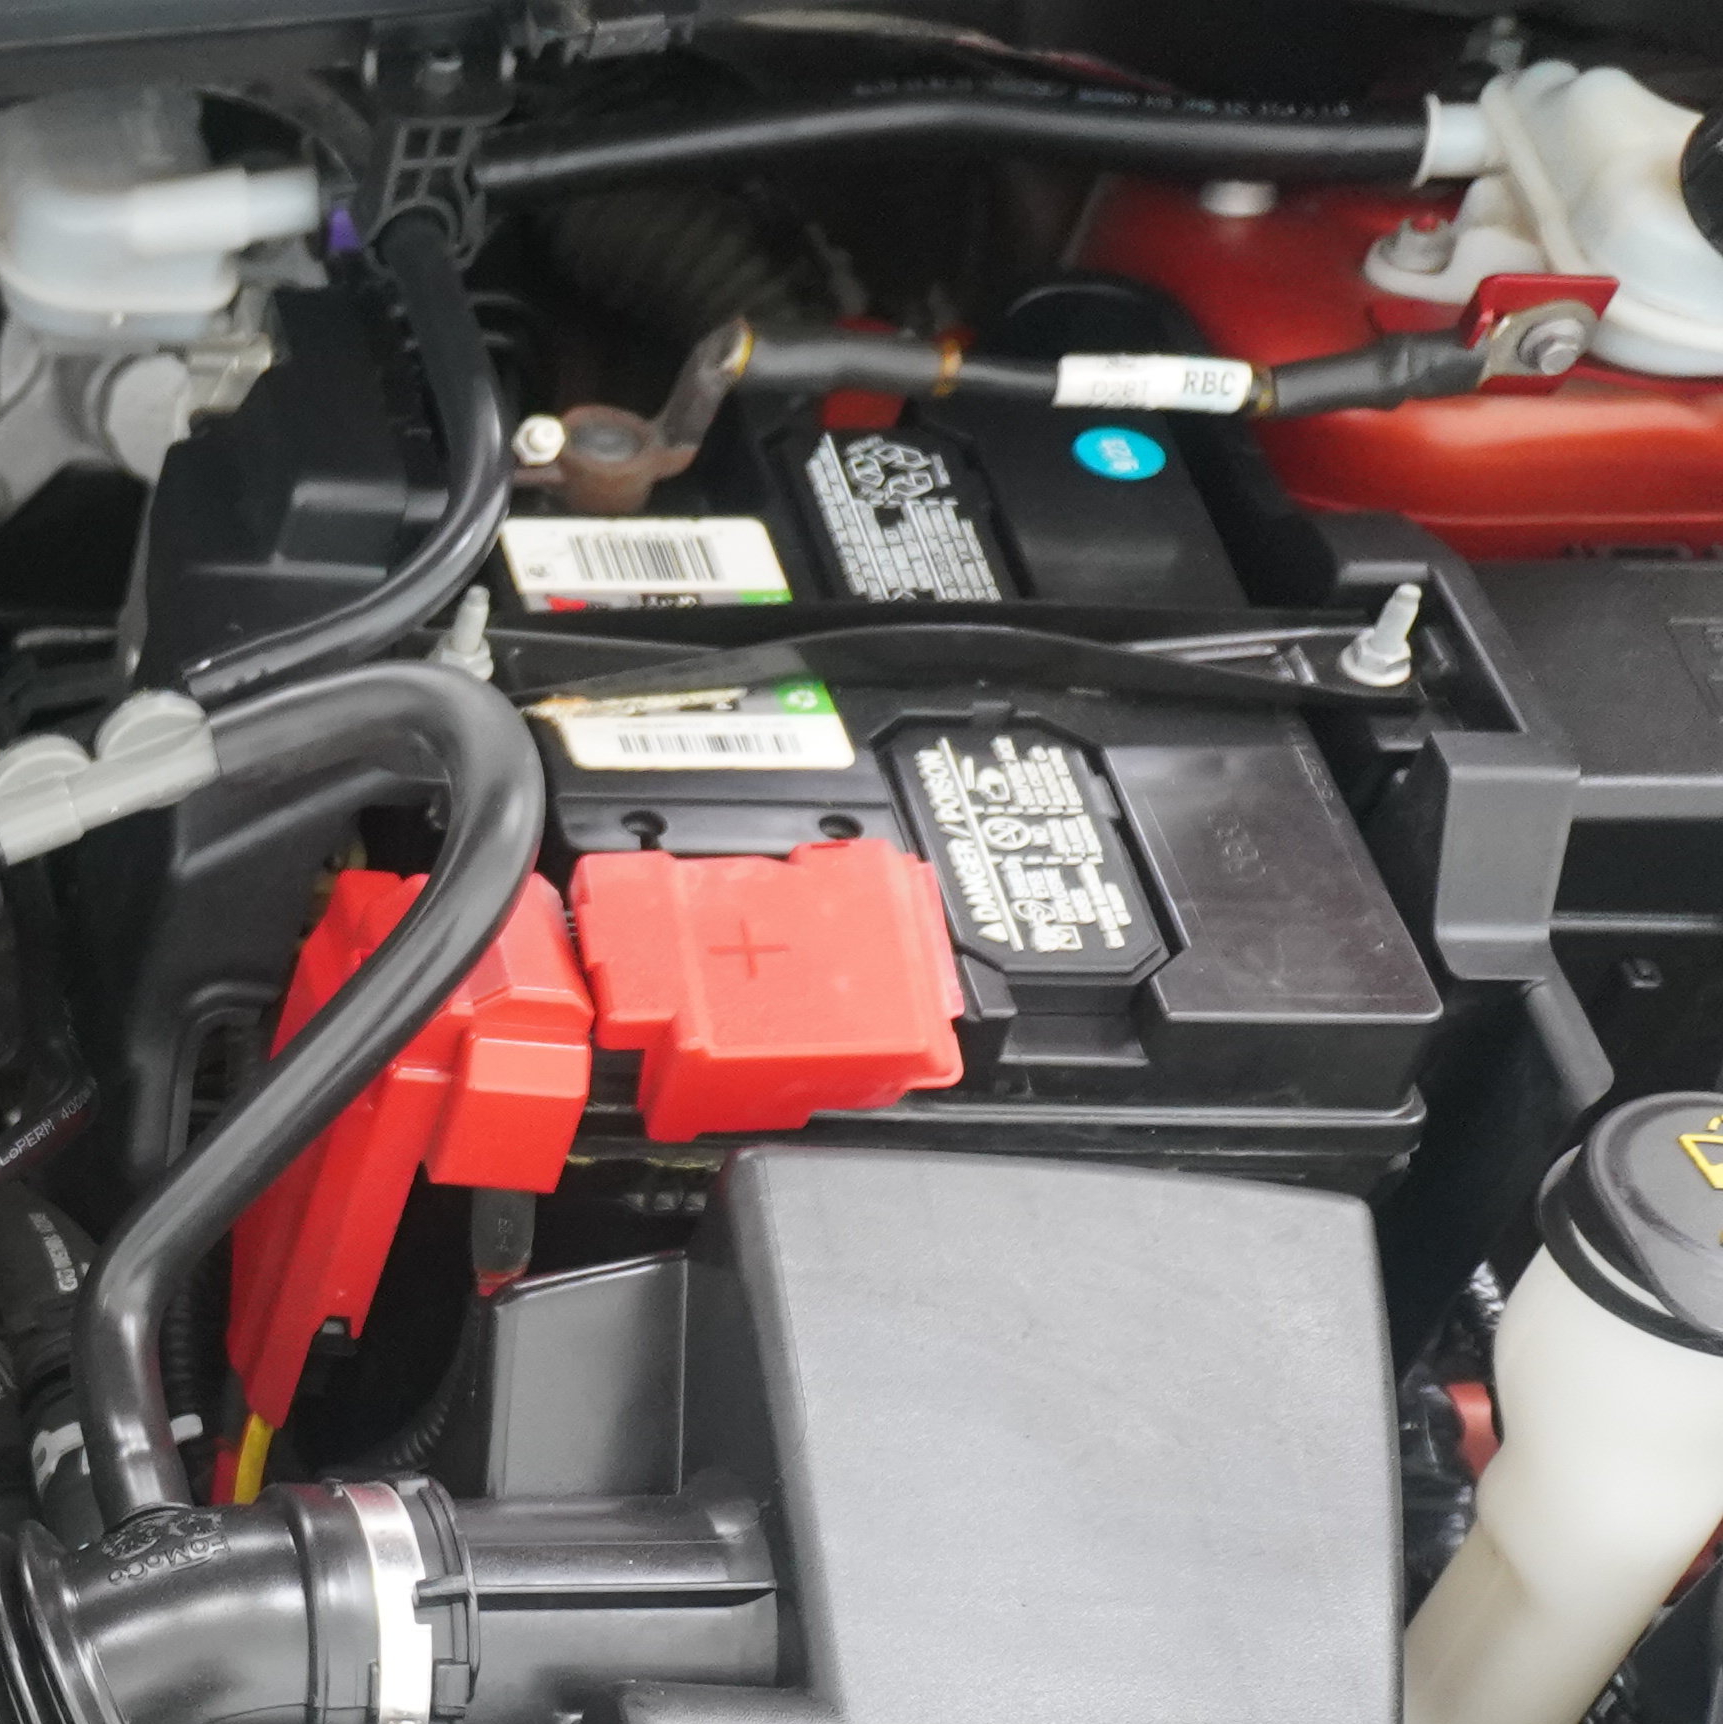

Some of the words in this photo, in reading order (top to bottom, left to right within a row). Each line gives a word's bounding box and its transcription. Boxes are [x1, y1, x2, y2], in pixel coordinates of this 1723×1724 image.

[1182, 370, 1237, 396] RBC
[913, 748, 966, 824] POISON
[945, 836, 1002, 923] DANGER
